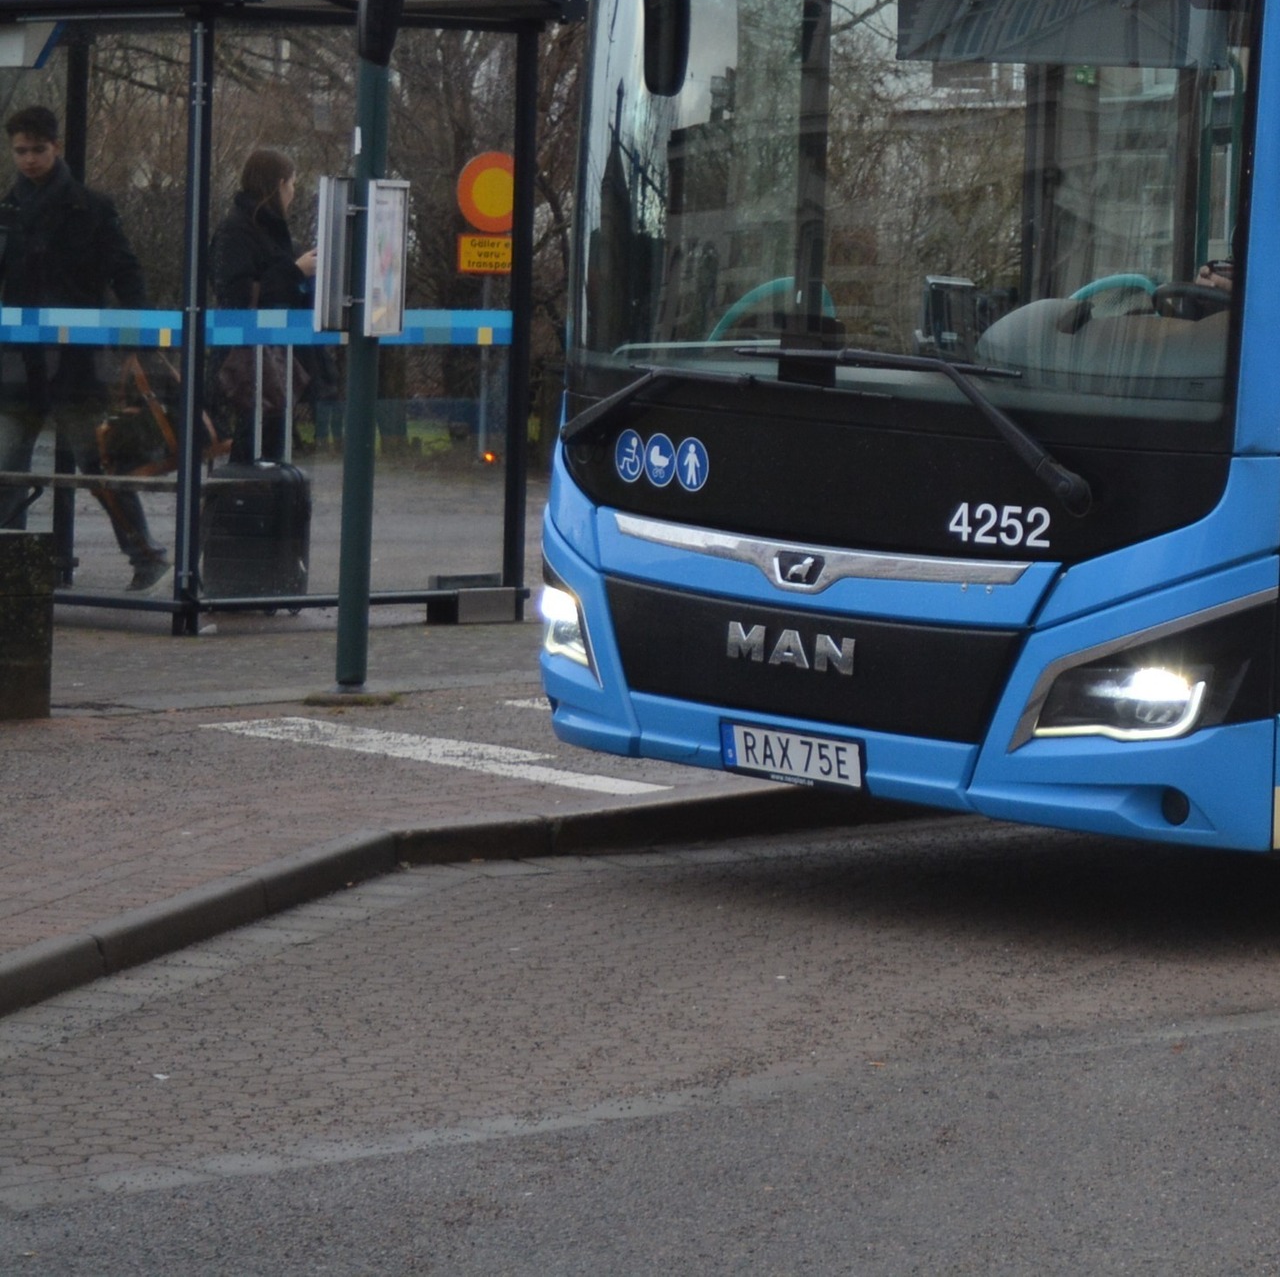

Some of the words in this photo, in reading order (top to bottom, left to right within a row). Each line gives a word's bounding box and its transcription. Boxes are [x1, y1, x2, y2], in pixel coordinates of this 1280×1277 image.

[949, 502, 1051, 548] 4252
[726, 621, 856, 676] MAN
[743, 730, 793, 771] RAX
[799, 739, 850, 780] 75E
